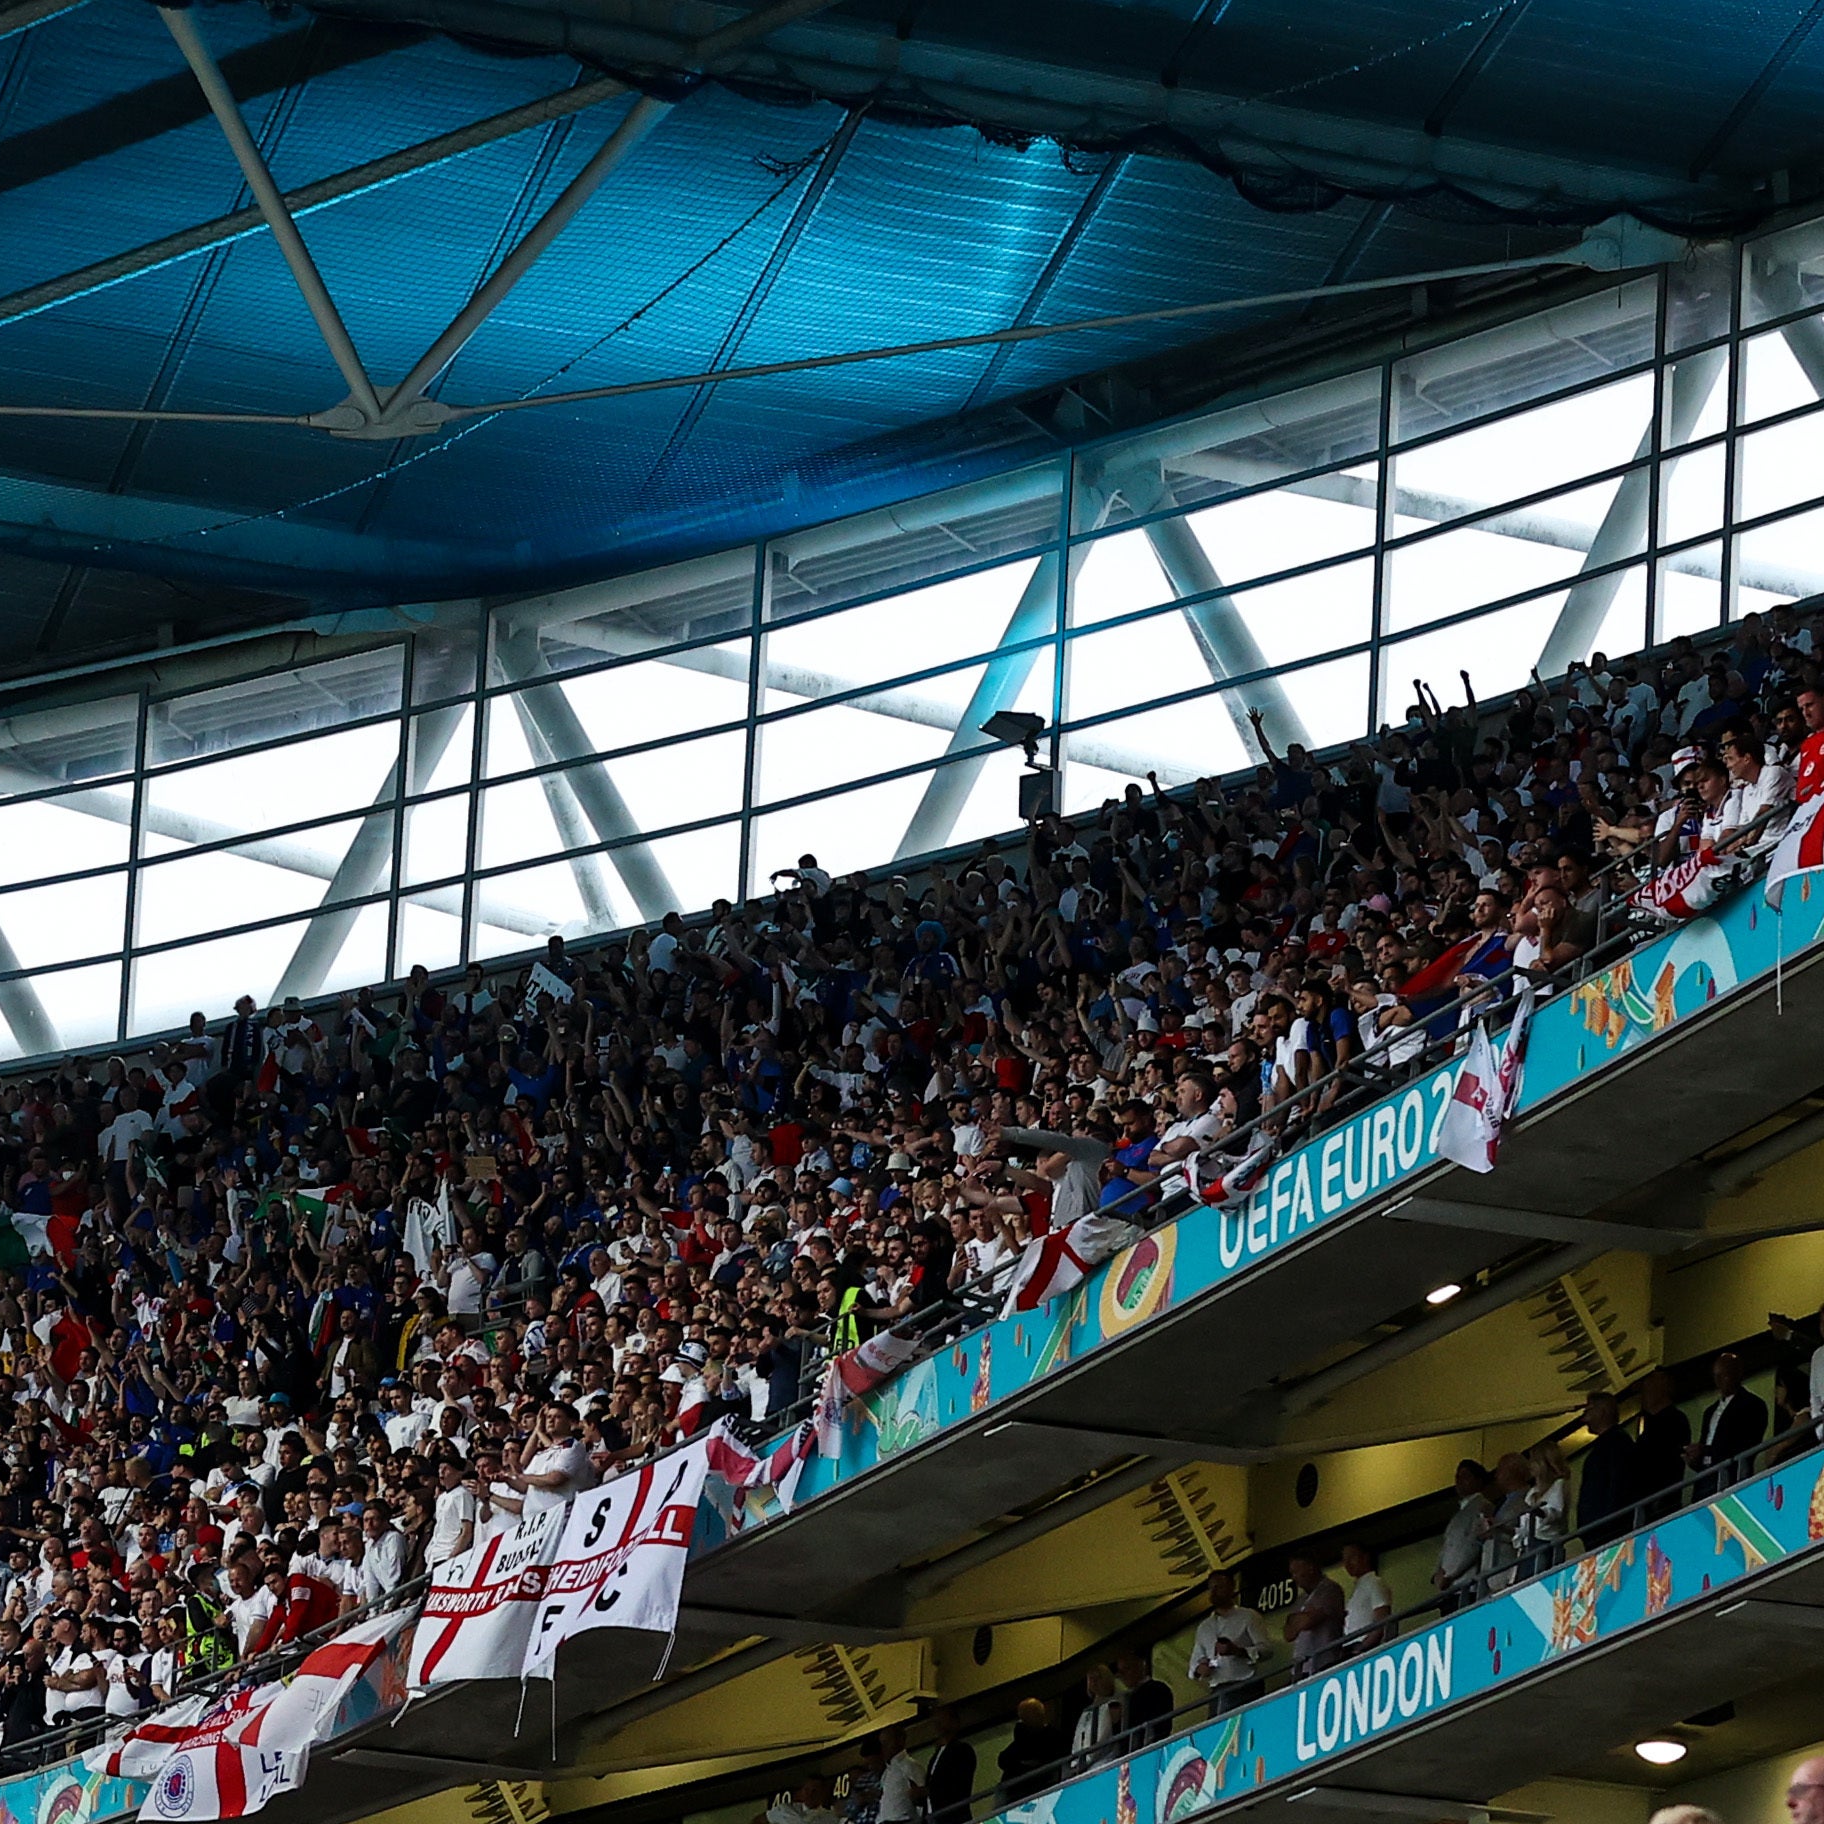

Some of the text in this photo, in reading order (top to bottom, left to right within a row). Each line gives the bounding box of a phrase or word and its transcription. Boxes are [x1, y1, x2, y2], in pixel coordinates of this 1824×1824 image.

[1218, 1157, 1315, 1268] UEFA
[1321, 1092, 1419, 1214] EURO
[1257, 1579, 1294, 1611] 4015
[1296, 1627, 1453, 1760] LONDON
